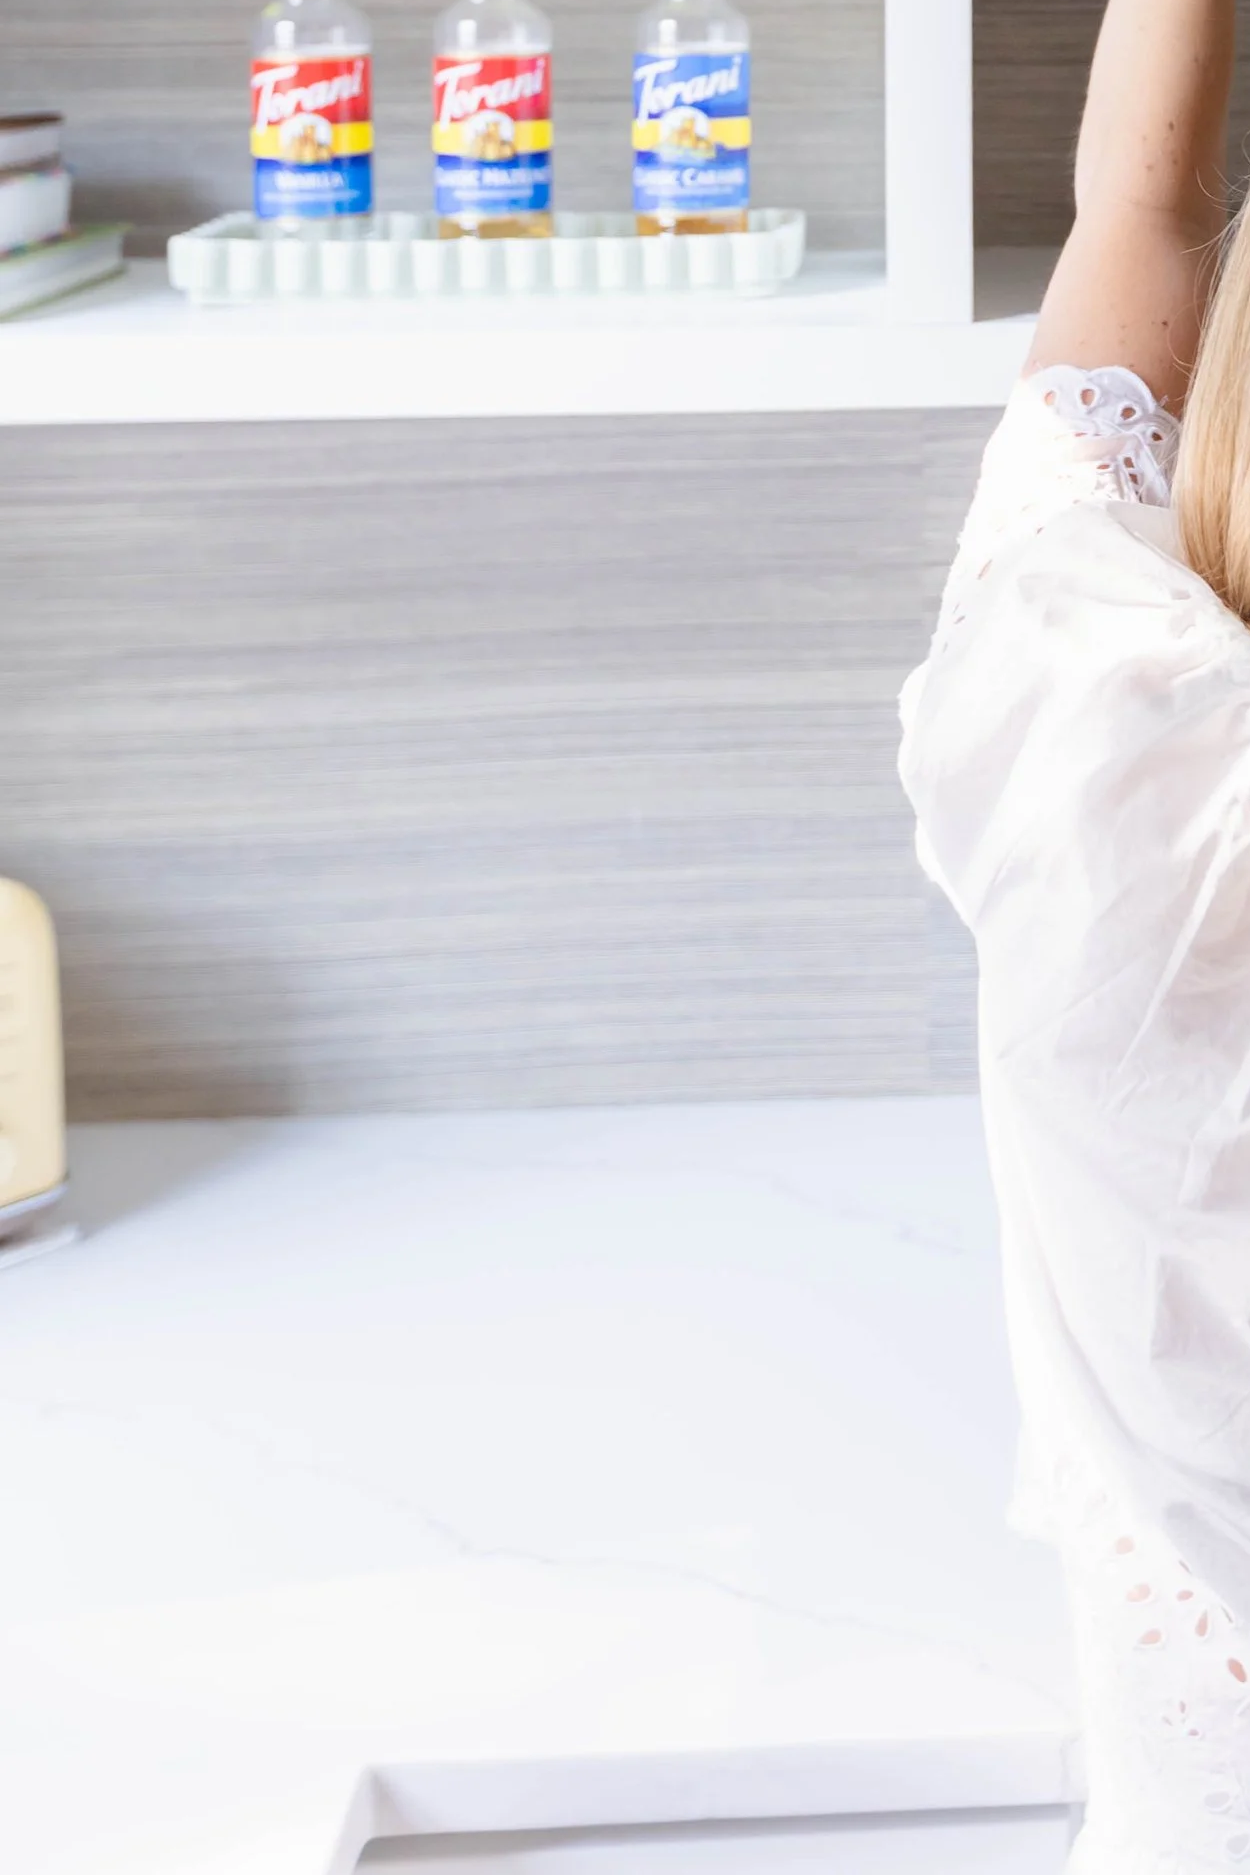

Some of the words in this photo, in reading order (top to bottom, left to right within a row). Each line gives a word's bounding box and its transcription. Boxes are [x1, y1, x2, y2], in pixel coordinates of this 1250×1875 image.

[250, 60, 365, 135] Torani
[434, 59, 546, 132] Torani
[633, 55, 743, 129] Torani
